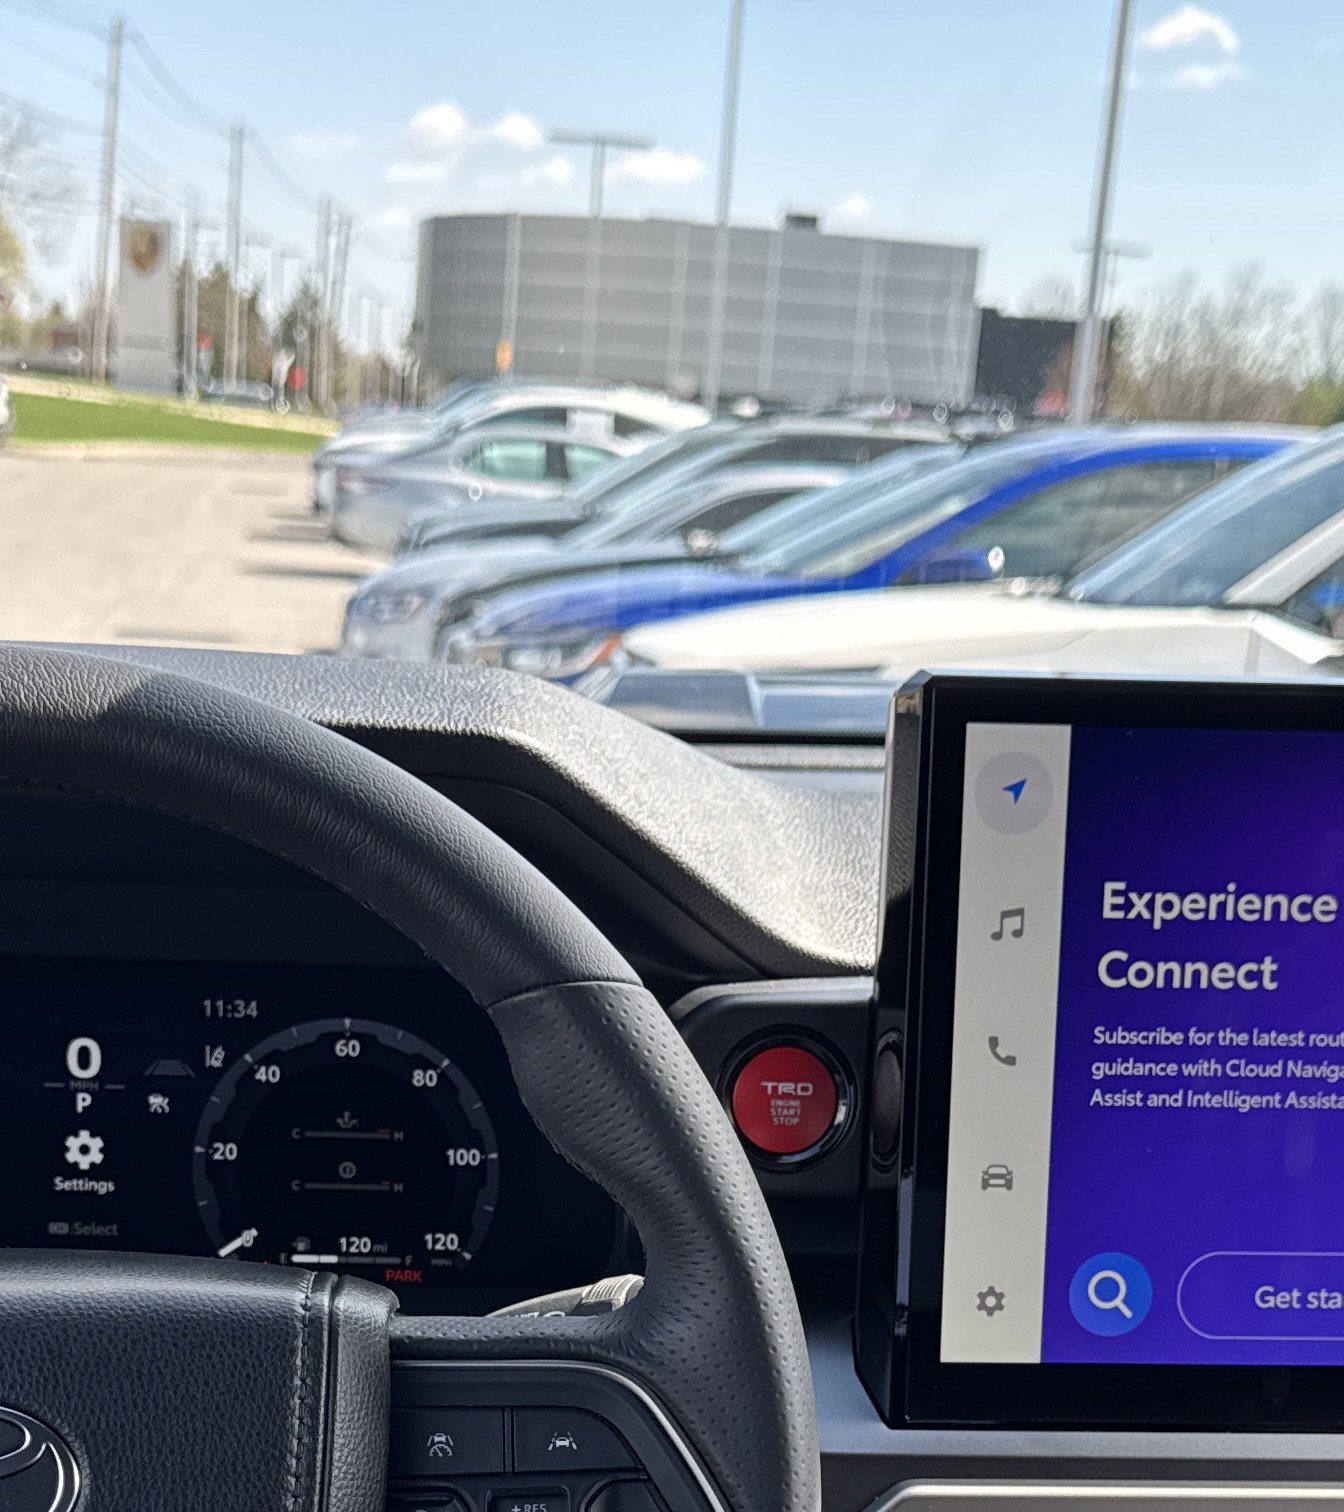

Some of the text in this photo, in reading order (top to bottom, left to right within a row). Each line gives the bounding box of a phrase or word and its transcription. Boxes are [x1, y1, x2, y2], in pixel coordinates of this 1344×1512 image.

[1102, 881, 1338, 929] Experience
[1097, 950, 1279, 990] Connect
[203, 1000, 257, 1018] 11:34
[1093, 1026, 1184, 1045] Subscribe
[1188, 1026, 1215, 1045] for
[1218, 1027, 1249, 1046] the
[1252, 1027, 1305, 1047] latest
[65, 1036, 102, 1079] 0
[334, 1039, 360, 1058] 60
[255, 1065, 280, 1083] 40
[411, 1069, 437, 1087] 80
[1091, 1057, 1178, 1080] guidance
[1181, 1058, 1222, 1077] with
[1226, 1059, 1283, 1078] Cloud
[760, 1081, 814, 1096] TRD
[75, 1091, 92, 1114] P
[770, 1099, 801, 1107] ENGINE
[1089, 1088, 1143, 1107] Assist
[1147, 1089, 1183, 1108] and
[1187, 1089, 1281, 1113] Intelligent
[770, 1107, 801, 1116] START
[772, 1117, 800, 1126] STOP
[212, 1142, 238, 1161] 20
[446, 1148, 480, 1166] 100
[54, 1176, 115, 1195] Settings
[338, 1236, 388, 1254] 120 mi
[423, 1232, 458, 1251] 120
[385, 1269, 423, 1282] PARK
[1254, 1286, 1301, 1310] Get
